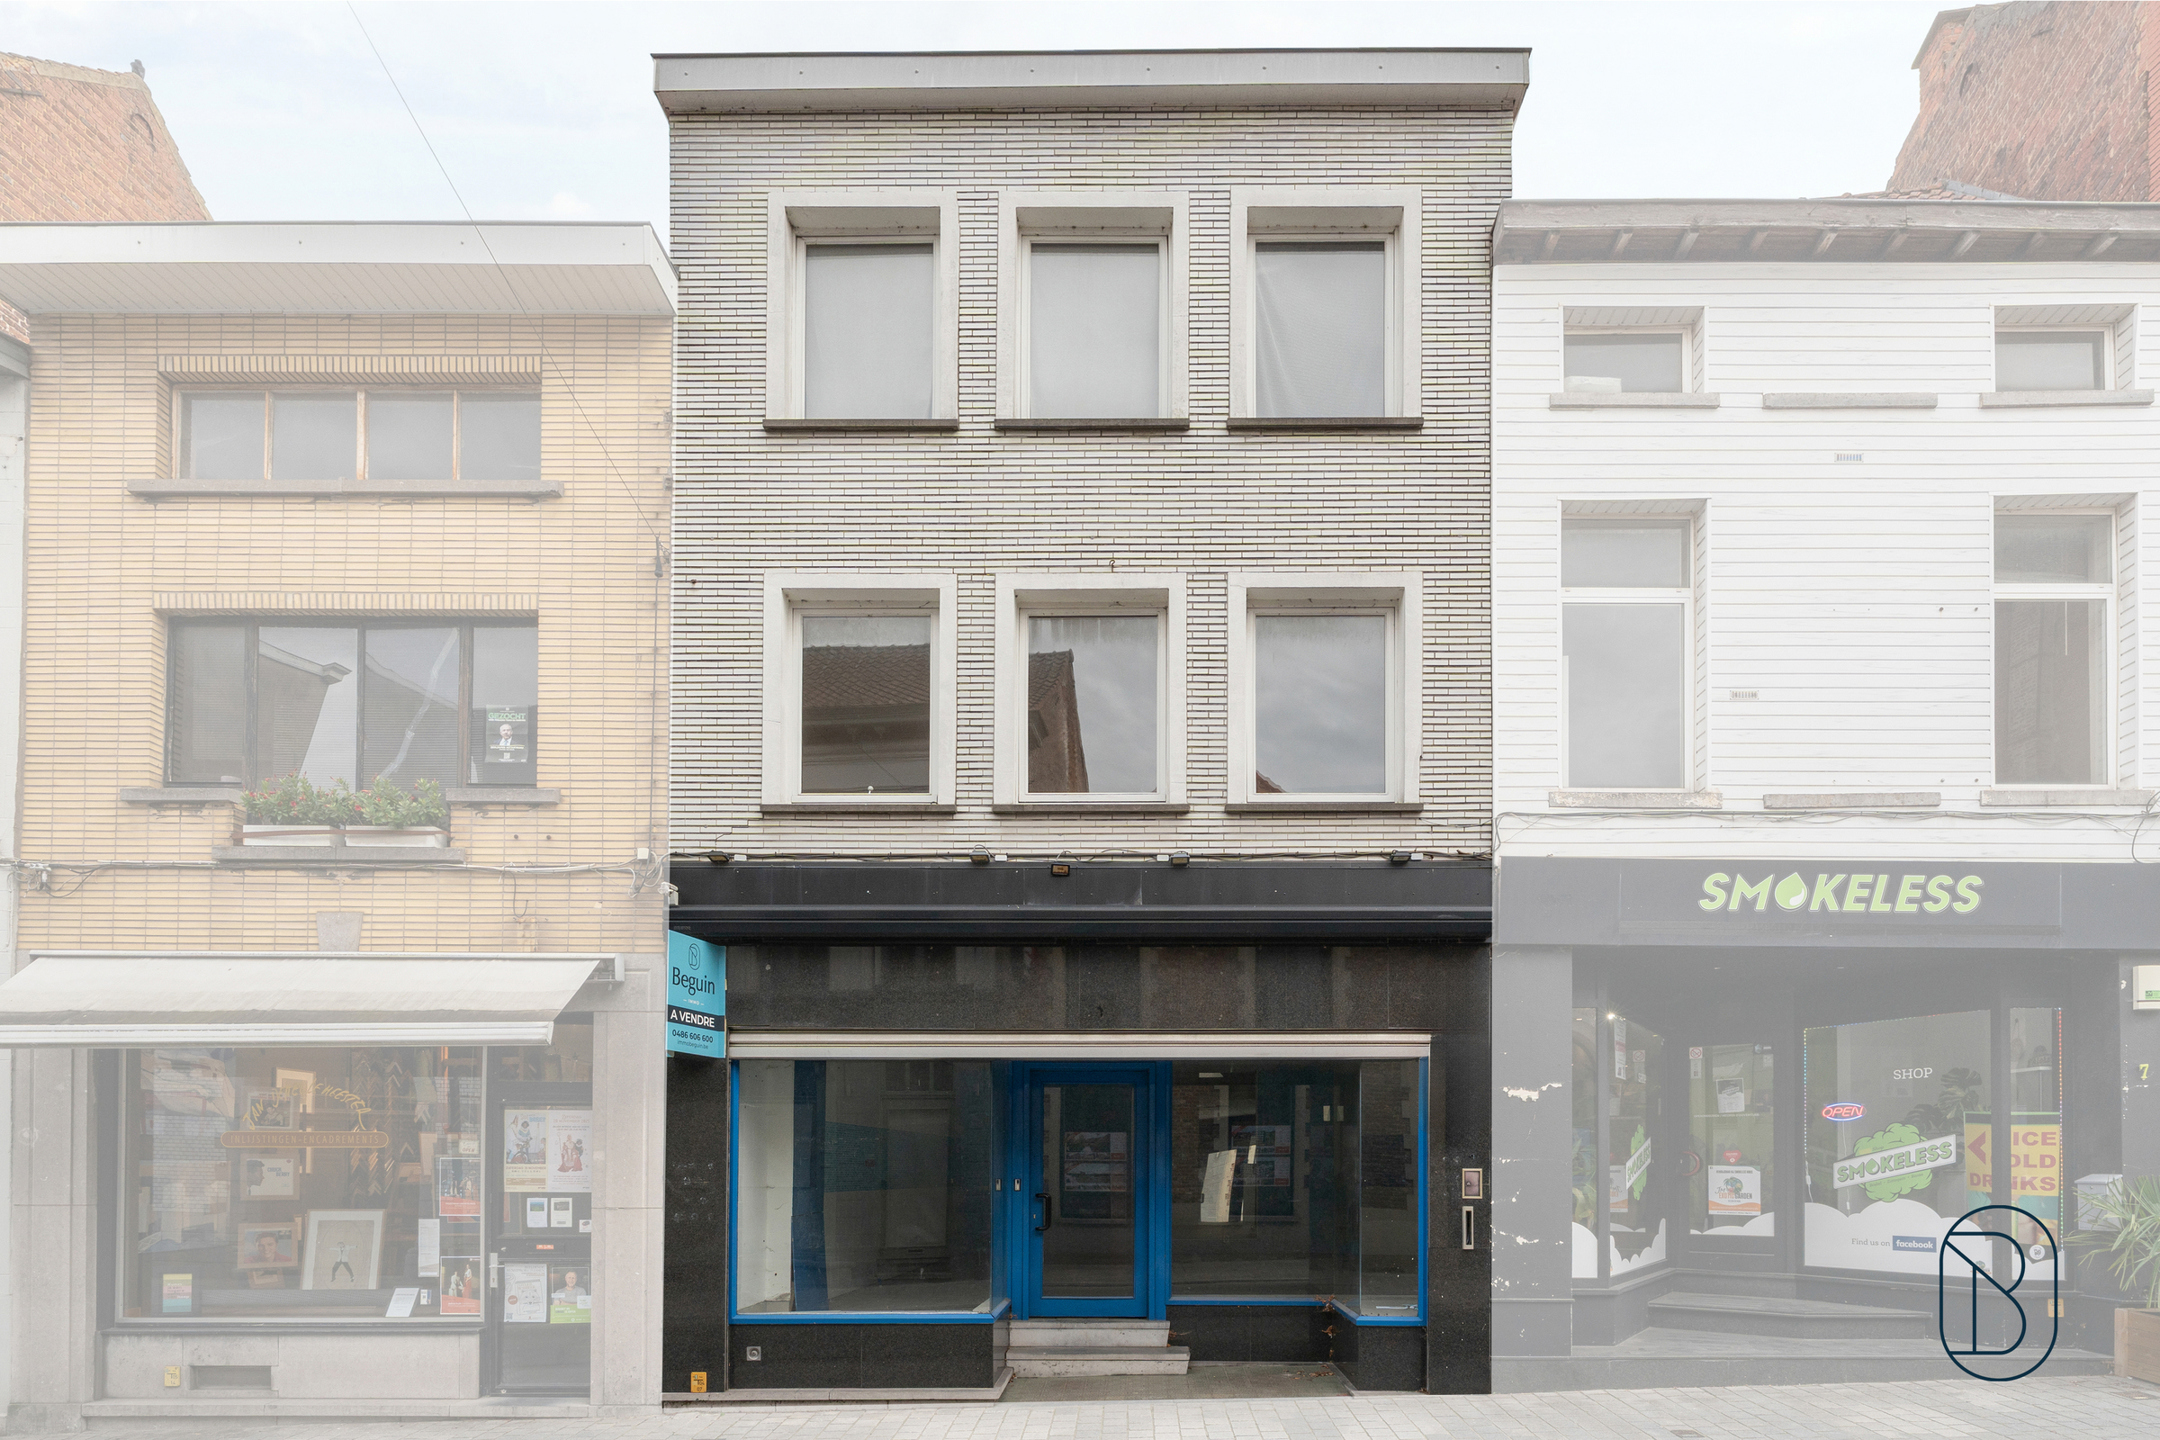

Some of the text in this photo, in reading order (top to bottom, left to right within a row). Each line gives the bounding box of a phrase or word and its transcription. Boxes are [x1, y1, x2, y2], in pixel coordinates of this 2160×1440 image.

[1699, 872, 1983, 913] SMOKELESS
[672, 966, 715, 996] Beguin
[670, 1009, 715, 1028] A VENDRE
[672, 1029, 714, 1043] 0486 606 600
[1893, 1067, 1933, 1080] SHOP
[2139, 1063, 2149, 1080] 7
[242, 1099, 264, 1131] JAN
[1821, 1105, 1864, 1117] OPEN
[2013, 1131, 2057, 1146] ICE
[1837, 1141, 1953, 1182] SMOKELESS
[1990, 1154, 2057, 1168] OLD
[1851, 1237, 1868, 1246] Find
[1895, 1239, 1934, 1249] facebook
